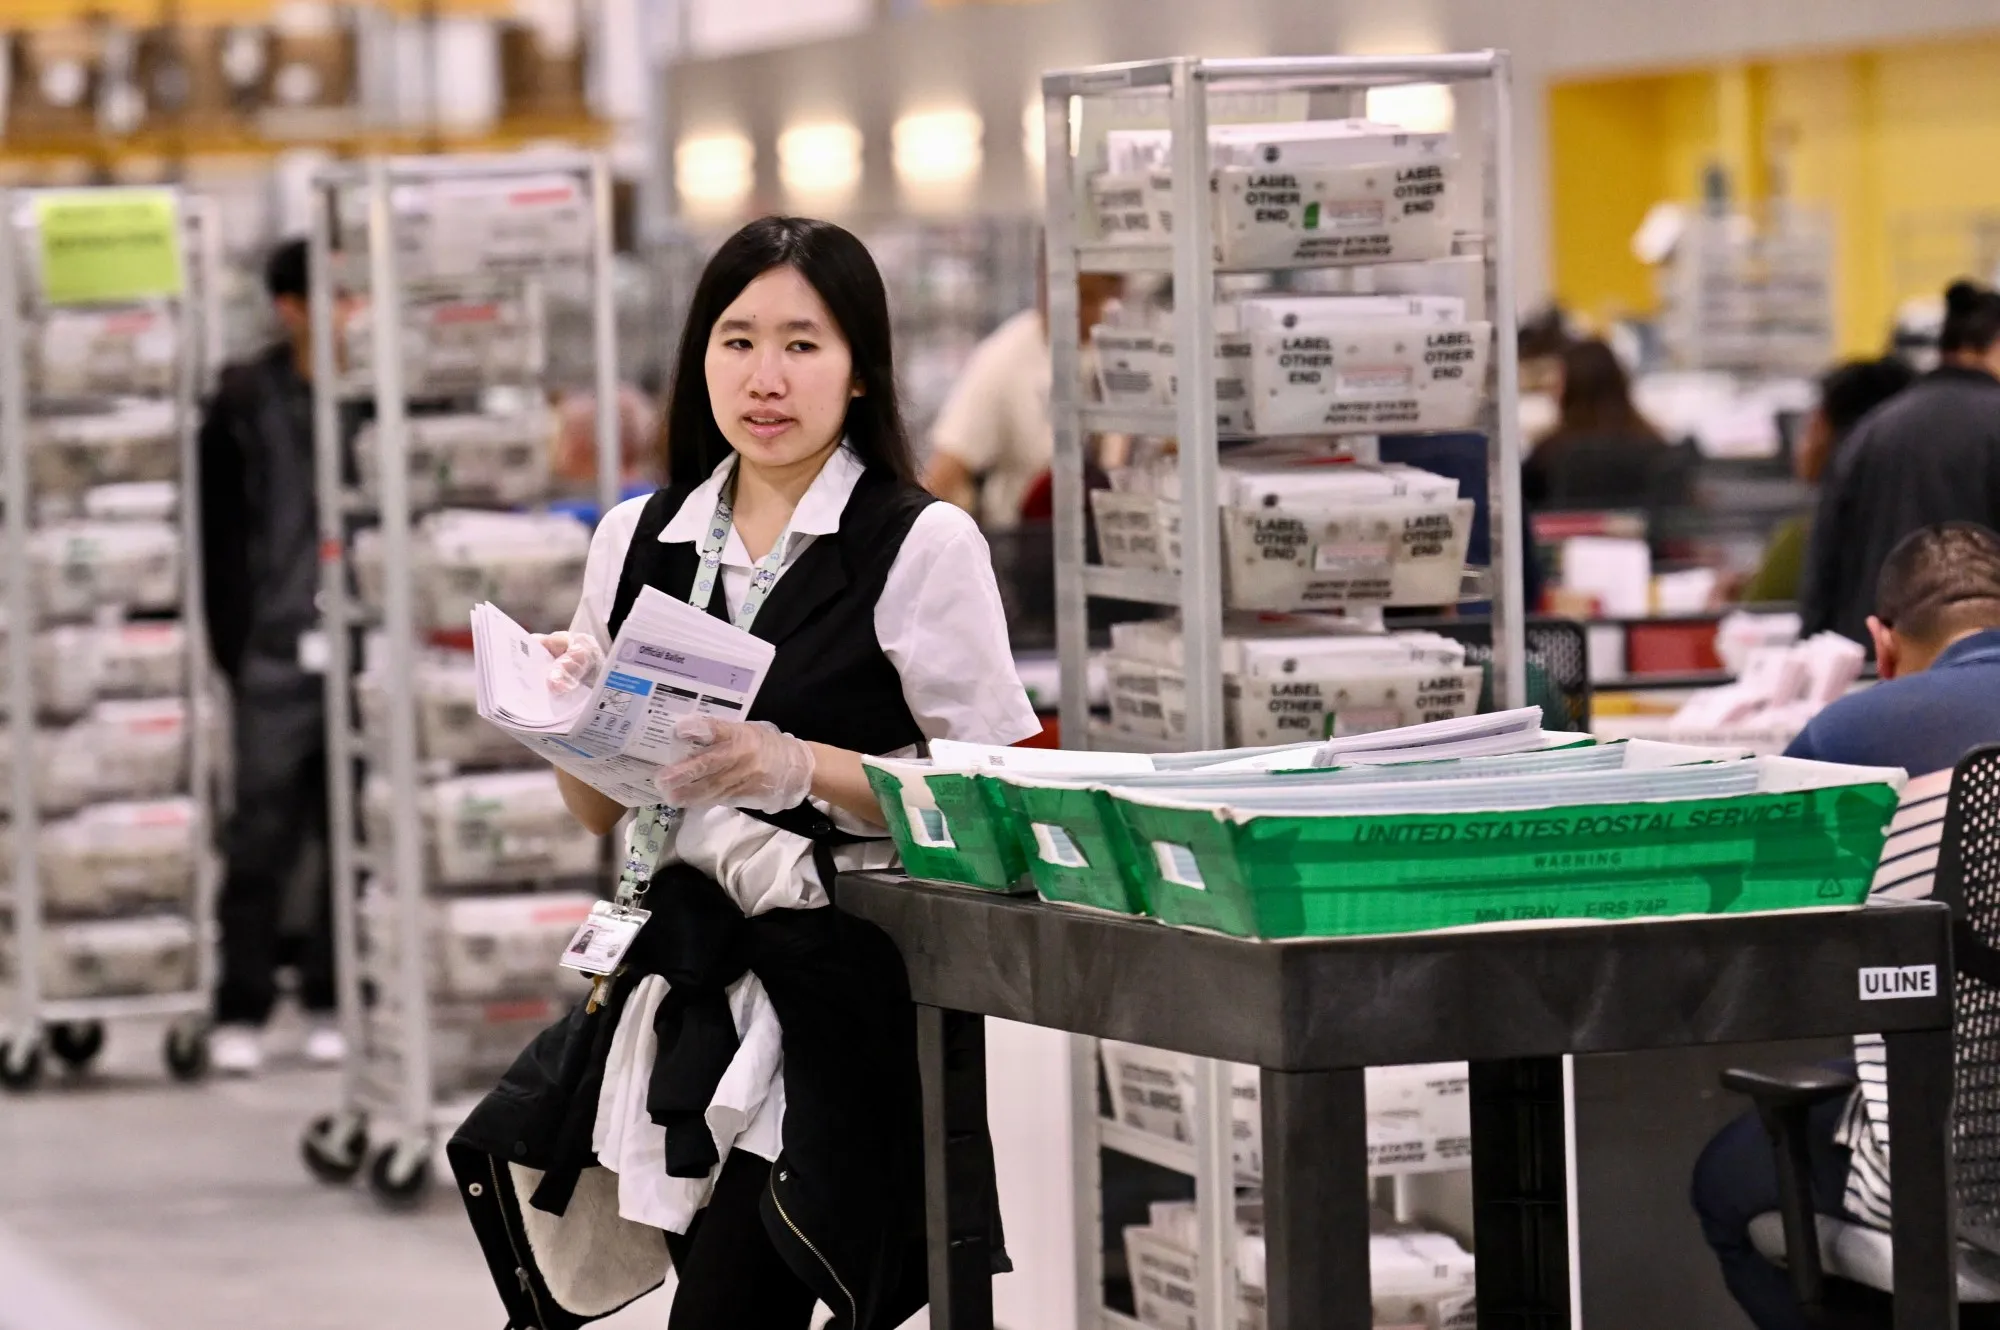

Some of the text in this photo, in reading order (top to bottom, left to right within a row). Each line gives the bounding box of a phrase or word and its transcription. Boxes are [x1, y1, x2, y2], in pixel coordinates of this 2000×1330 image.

[1395, 166, 1442, 181] LABEL
[1248, 174, 1298, 188] LABEL
[1394, 182, 1444, 198] OTHER
[1245, 191, 1300, 205] OTHER
[1403, 200, 1435, 215] END
[1255, 209, 1289, 222] END
[1282, 337, 1331, 350] LABEL
[1426, 331, 1473, 347] LABEL
[1279, 353, 1333, 367] OTHER
[1424, 349, 1474, 364] OTHER
[1288, 371, 1322, 384] END
[1432, 366, 1463, 380] END
[1255, 519, 1304, 531] LABEL
[1404, 514, 1452, 528] LABEL
[1254, 532, 1308, 545] OTHER
[1402, 530, 1453, 544] OTHER
[1262, 546, 1296, 560] END
[1410, 543, 1442, 557] END
[639, 645, 685, 664] Official Ballot
[1271, 683, 1322, 697] LABEL
[1418, 677, 1463, 692] LABEL
[1268, 699, 1323, 713] OTHER
[1416, 692, 1465, 708] OTHER
[1277, 716, 1311, 730] END
[1353, 802, 1802, 846] UNITED STATES POSTAL SERVICE
[1533, 851, 1622, 869] WARNING
[1865, 971, 1930, 993] ULINE
